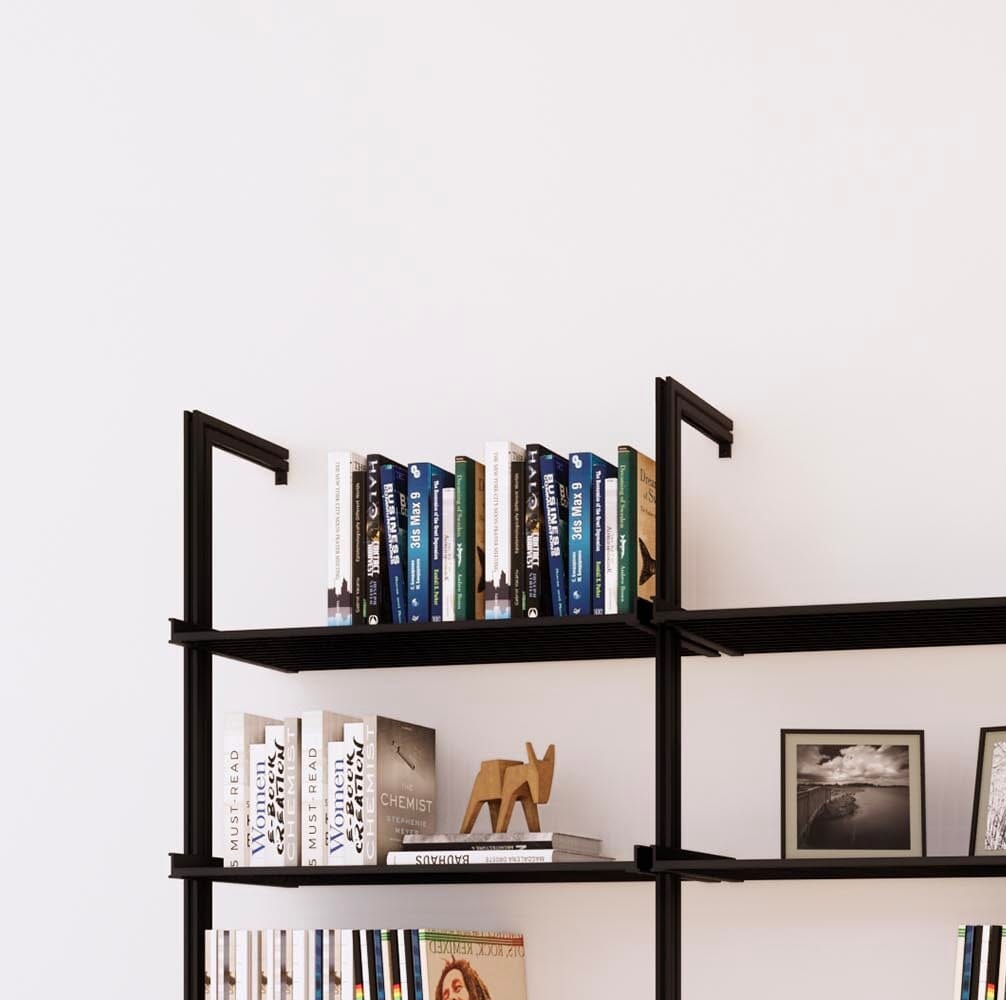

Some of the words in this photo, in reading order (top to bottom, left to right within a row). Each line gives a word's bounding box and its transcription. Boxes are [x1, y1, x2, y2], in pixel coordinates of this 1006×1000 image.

[368, 460, 378, 520] HALO
[410, 502, 420, 525] Max
[528, 450, 538, 510] HALO
[548, 474, 561, 556] BUSINESS
[572, 493, 583, 516] Max
[387, 483, 400, 565] BUSINESS
[410, 528, 420, 548] 3ds
[571, 520, 582, 540] 3ds
[230, 750, 239, 851] MUST-READ
[251, 761, 266, 856] Women
[268, 750, 276, 844] E-BOOK
[275, 738, 285, 855] CREATION
[287, 727, 295, 860] CHEMIST
[308, 747, 317, 849] MUST-READ
[329, 759, 345, 854] Women
[346, 749, 354, 842] E-BOOK
[353, 735, 364, 854] CREATION
[366, 724, 375, 860] CHEMIST
[380, 792, 432, 813] CHEMIST
[415, 855, 470, 865] BAUHAUS
